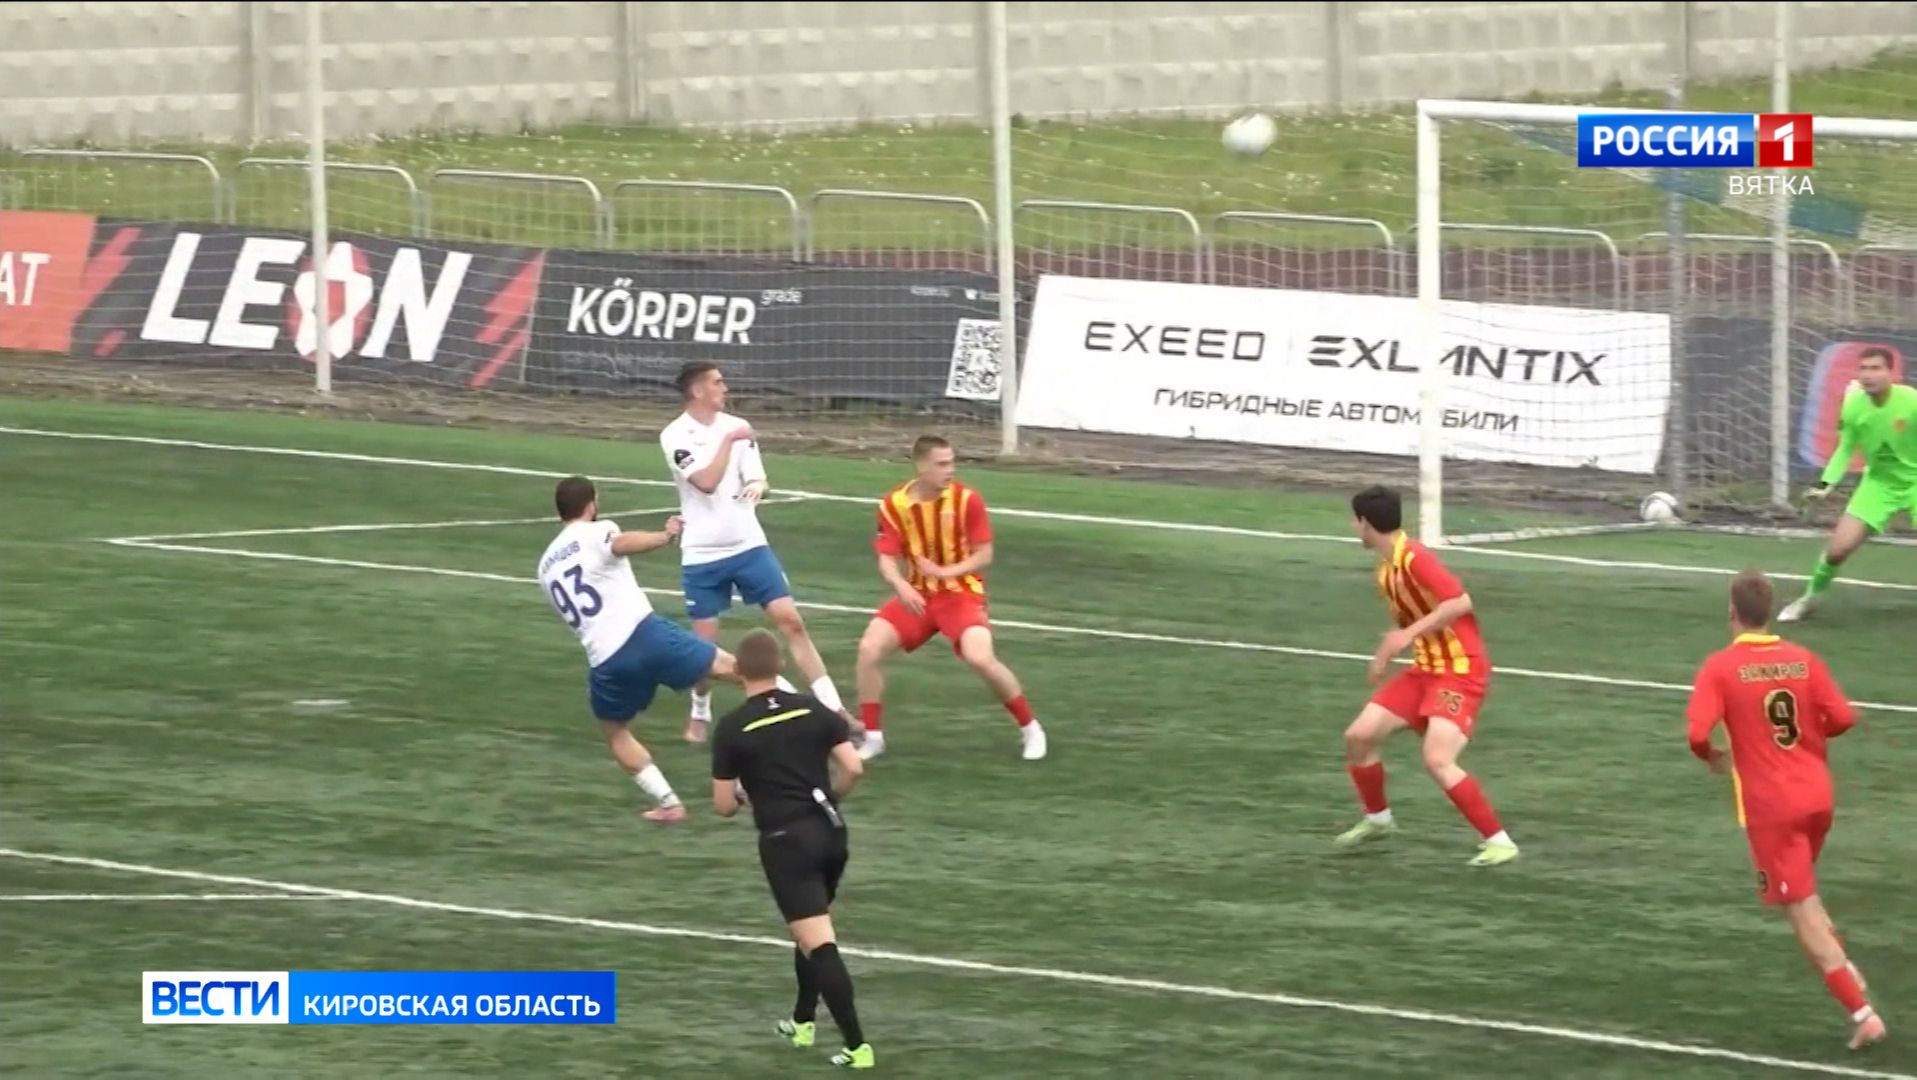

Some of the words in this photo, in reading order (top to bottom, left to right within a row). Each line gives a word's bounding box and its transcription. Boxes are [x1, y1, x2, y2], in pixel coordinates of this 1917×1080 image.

[141, 232, 473, 362] LEON
[761, 288, 801, 306] grade
[1084, 321, 1266, 362] EXEED
[1154, 388, 1323, 418] ГИБРИДНЫЕ
[1327, 400, 1519, 433] АВТОМБИЛИ
[550, 564, 604, 629] 93
[1436, 689, 1464, 715] 75
[1764, 688, 1801, 750] 9
